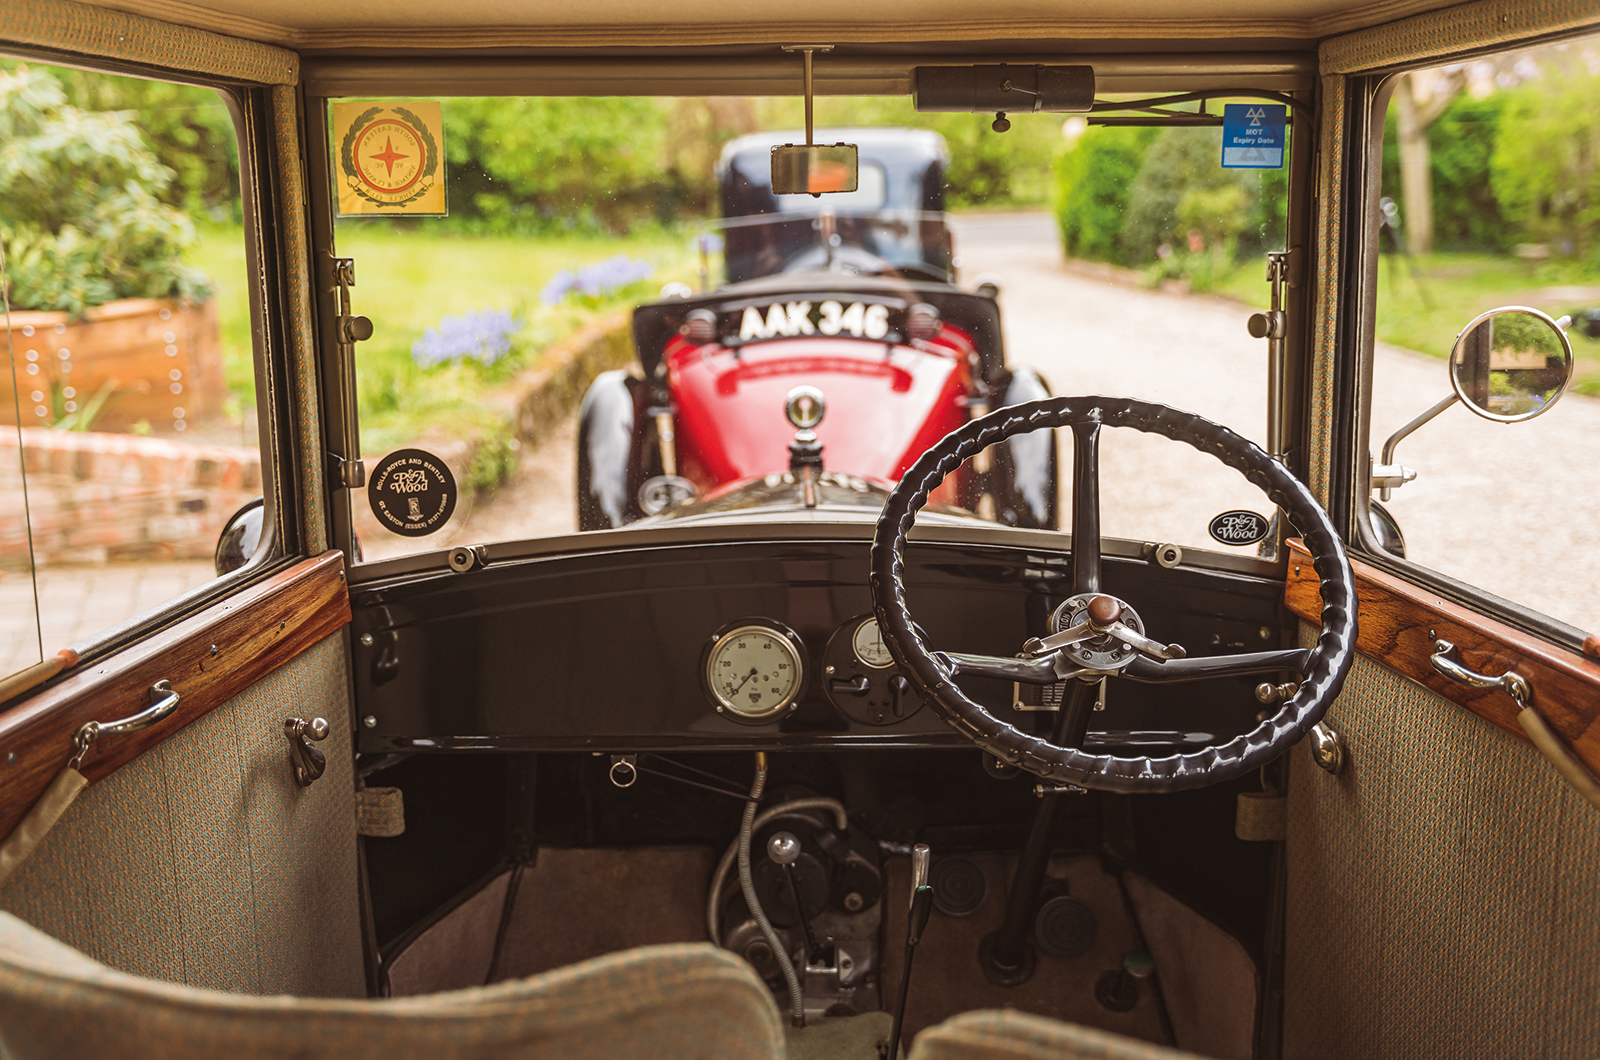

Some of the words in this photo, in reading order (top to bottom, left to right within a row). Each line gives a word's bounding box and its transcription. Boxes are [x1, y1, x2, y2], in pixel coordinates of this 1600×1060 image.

[1233, 137, 1256, 145] Expiry
[738, 300, 816, 342] AAK
[817, 300, 890, 340] 346
[376, 458, 406, 491] ROLLS-ROYCE
[423, 461, 446, 483] BENTLEY
[393, 468, 426, 485] P&A
[390, 480, 428, 494] Wood
[384, 510, 404, 527] EASTON
[1222, 514, 1257, 531] P&A
[1217, 527, 1258, 539] Wood
